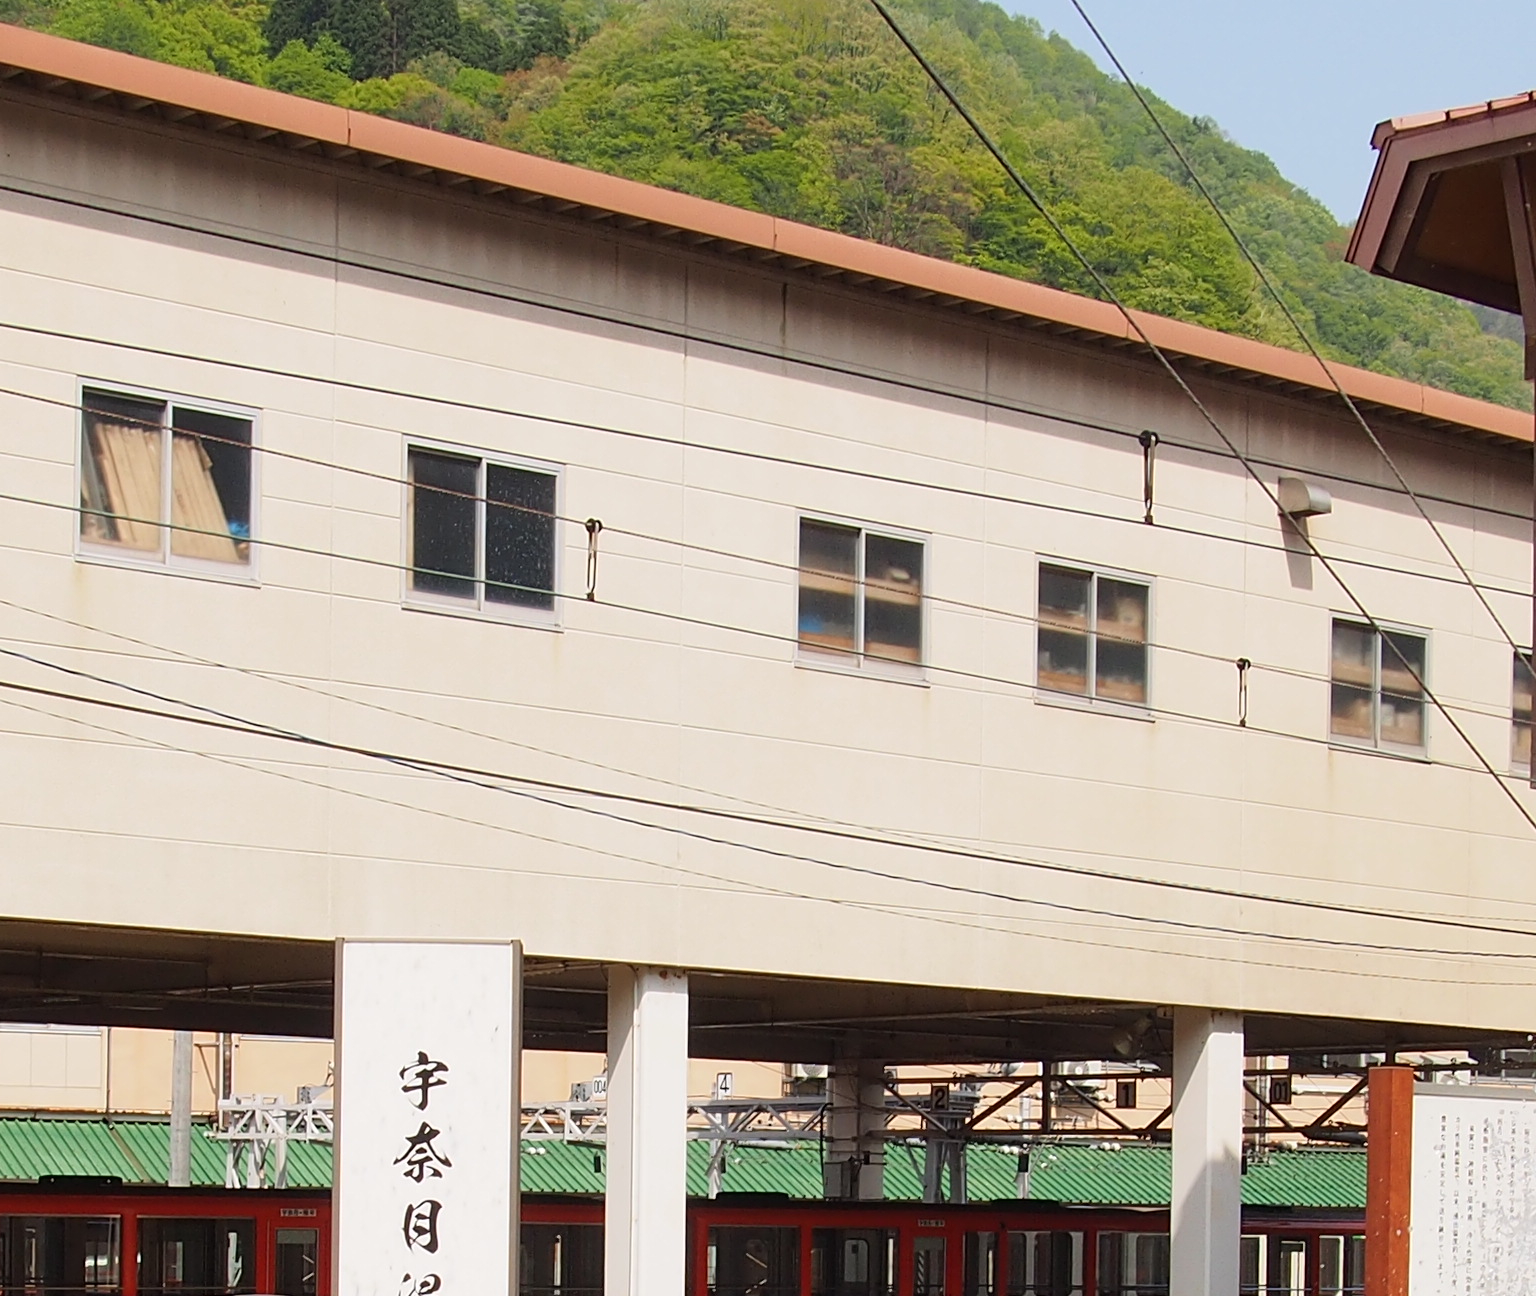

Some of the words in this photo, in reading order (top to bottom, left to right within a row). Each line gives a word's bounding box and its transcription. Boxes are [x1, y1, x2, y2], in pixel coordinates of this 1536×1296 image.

[719, 1073, 730, 1093] 4
[1274, 1081, 1288, 1102] 01
[934, 1087, 946, 1109] 2
[1122, 1084, 1129, 1106] 1
